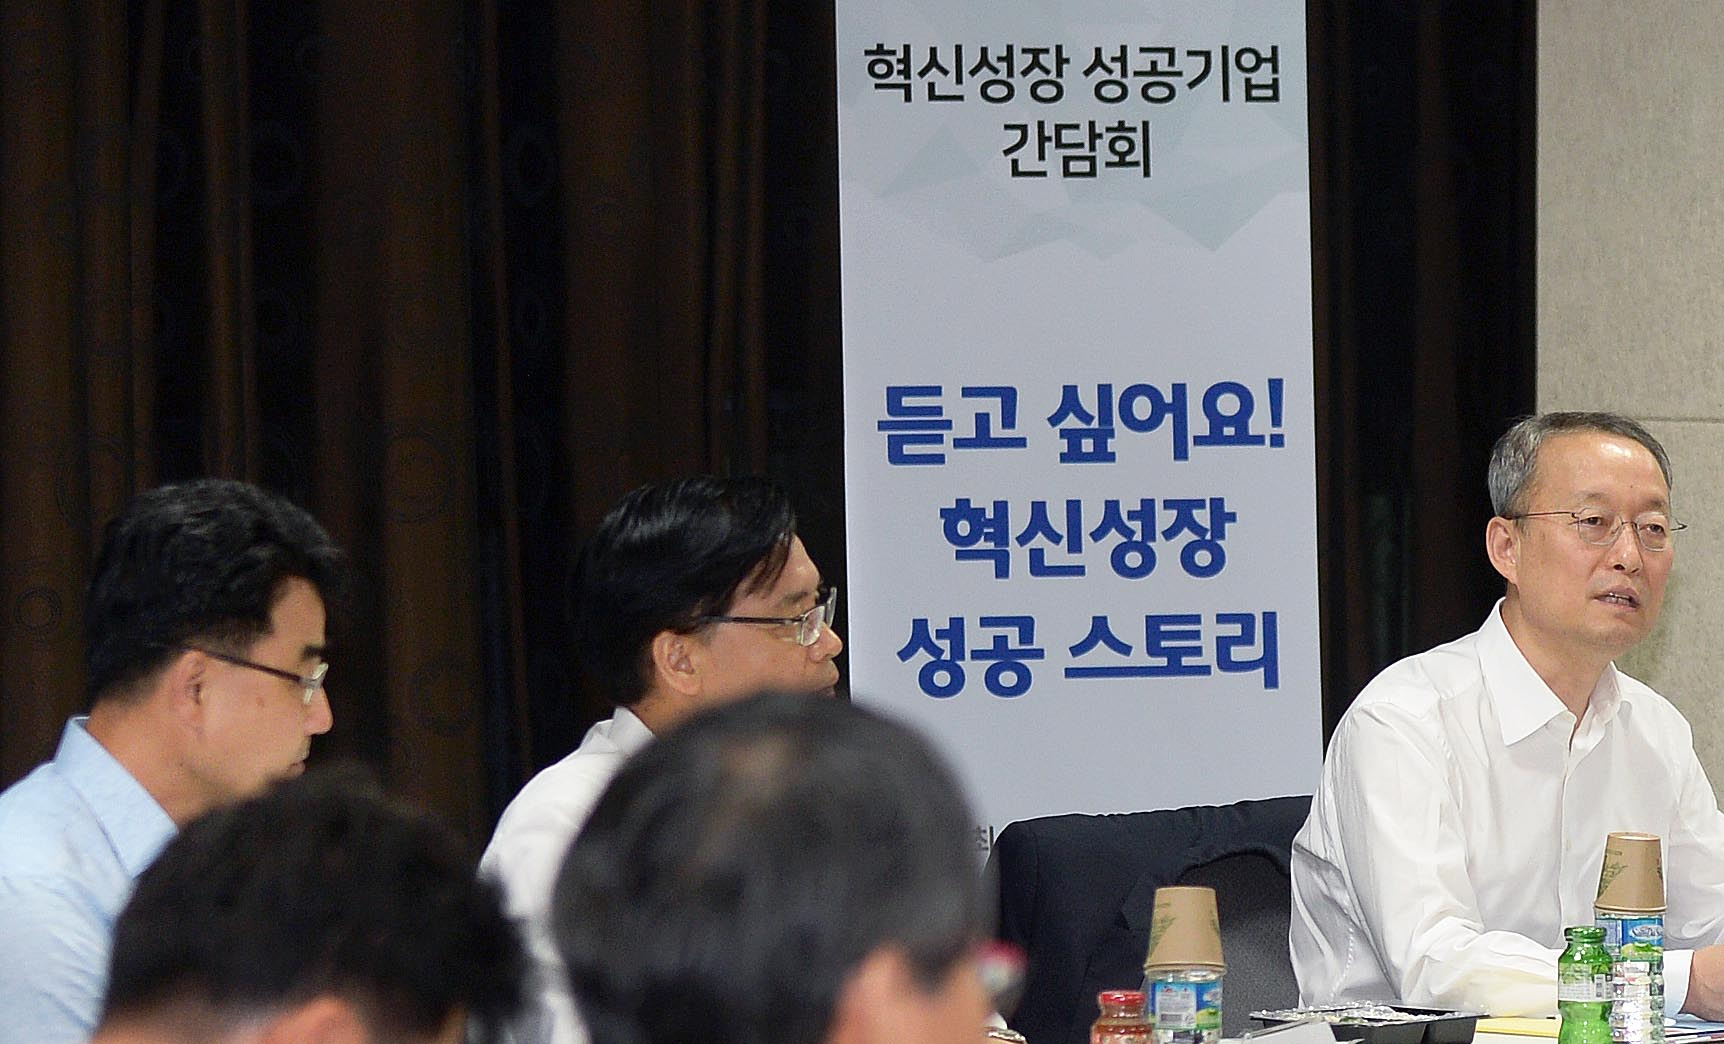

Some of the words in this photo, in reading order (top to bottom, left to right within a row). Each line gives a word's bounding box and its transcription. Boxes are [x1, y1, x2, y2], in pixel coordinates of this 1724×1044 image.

[863, 43, 1070, 104] 혁신성장
[1082, 44, 1281, 104] 성공기업
[1002, 120, 1152, 178] 간담회
[877, 385, 1028, 466] 듣고
[1047, 378, 1285, 464] 싶어요!
[939, 497, 1238, 580] 혁신성장
[897, 616, 1045, 698] 성공
[1064, 611, 1279, 690] 스토리
